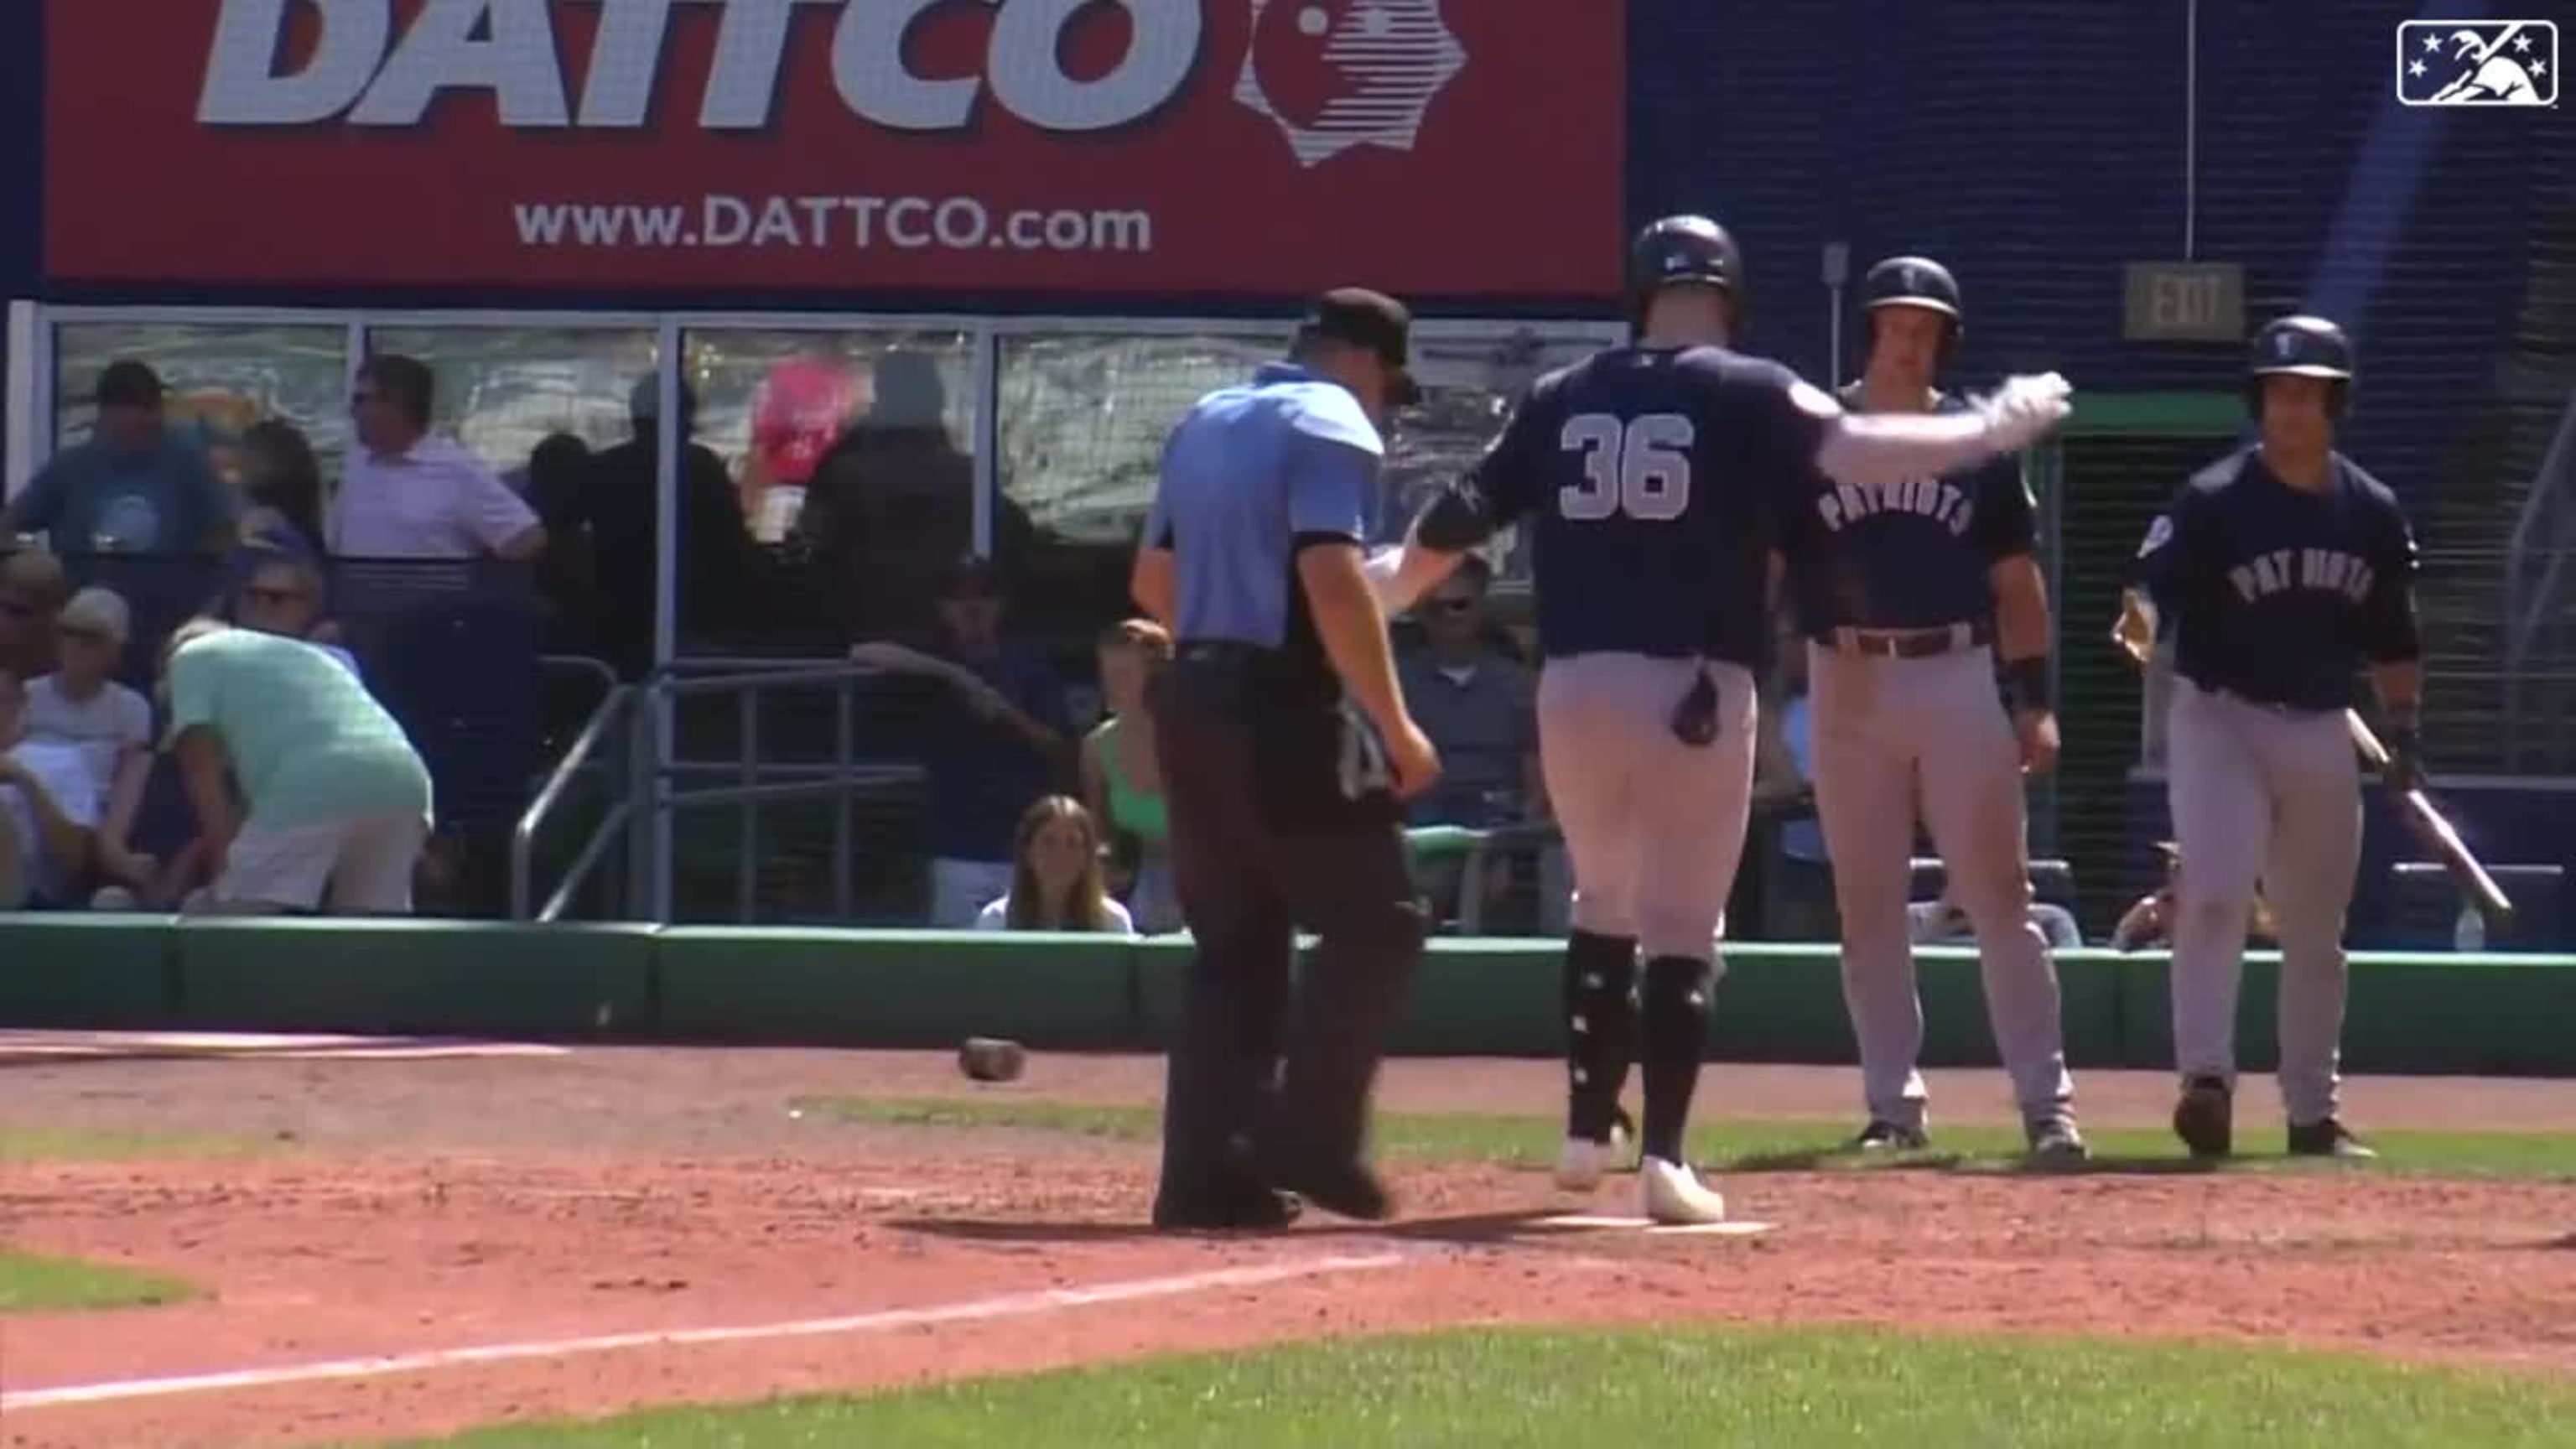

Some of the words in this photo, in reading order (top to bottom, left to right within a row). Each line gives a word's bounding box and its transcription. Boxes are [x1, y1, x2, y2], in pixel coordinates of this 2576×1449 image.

[197, 0, 1200, 131] DATTCO
[514, 195, 1152, 252] www.DATTCO.com
[2155, 275, 2224, 324] EXIT
[1560, 413, 1695, 521] 36
